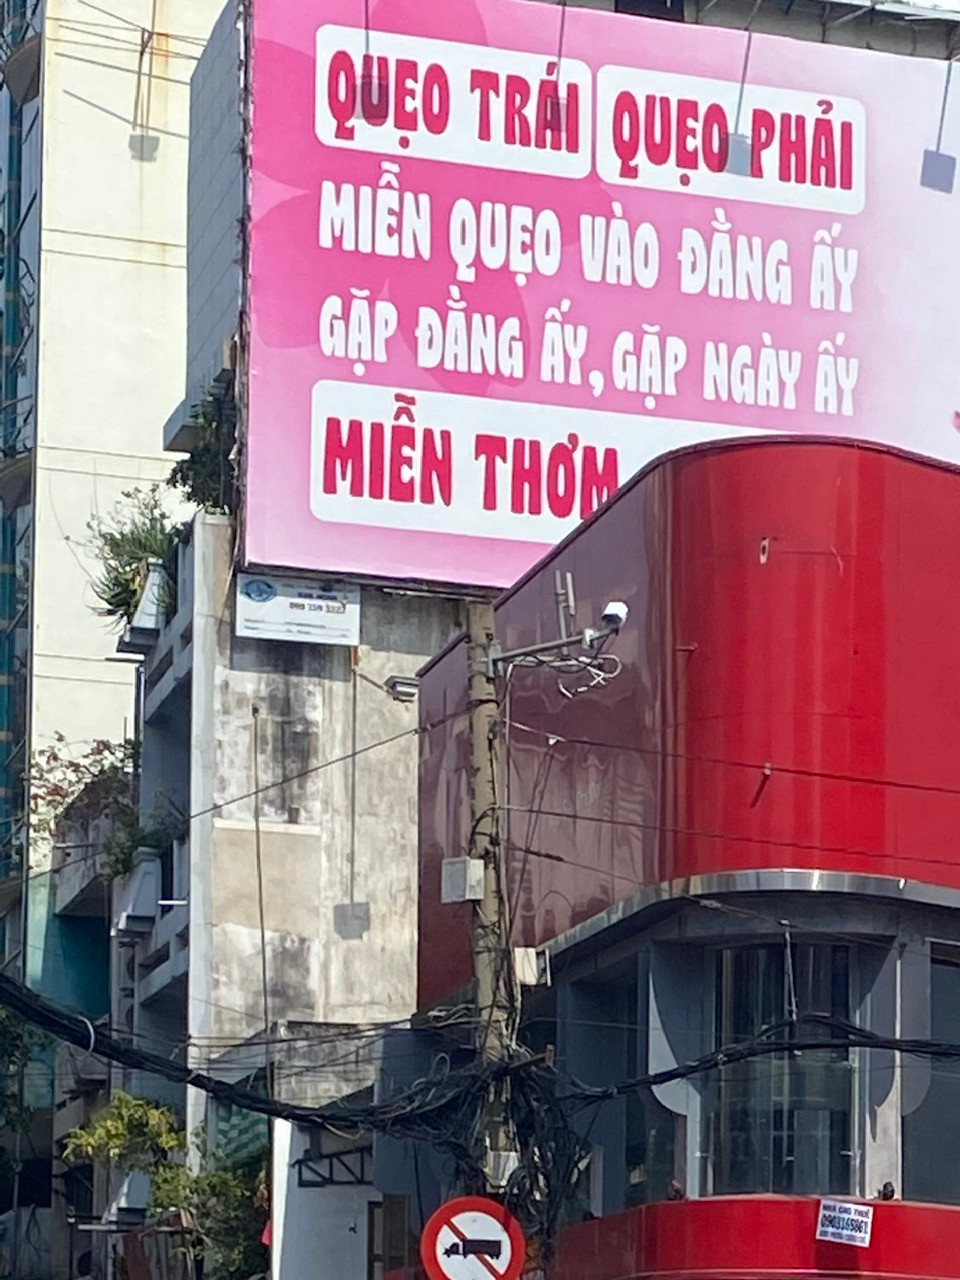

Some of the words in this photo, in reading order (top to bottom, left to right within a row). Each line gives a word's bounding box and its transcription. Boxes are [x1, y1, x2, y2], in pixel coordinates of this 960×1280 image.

[327, 50, 450, 149] QUẸO
[470, 61, 579, 153] TRÁI
[612, 91, 728, 186] QUẸO
[750, 100, 853, 190] PHẢI
[319, 161, 431, 260] MIỄN
[449, 198, 561, 287] QUẸO
[580, 201, 659, 288] VÀO
[678, 208, 792, 305] ĐẰNG
[809, 222, 858, 312] ẤY
[319, 288, 397, 376] GẶP
[415, 284, 524, 379] ĐẰNG
[612, 323, 687, 409] GẶP
[703, 332, 801, 410] NGÀY
[814, 332, 859, 416] ẤY
[322, 393, 452, 506] MIỄN
[474, 433, 619, 521] THƠM
